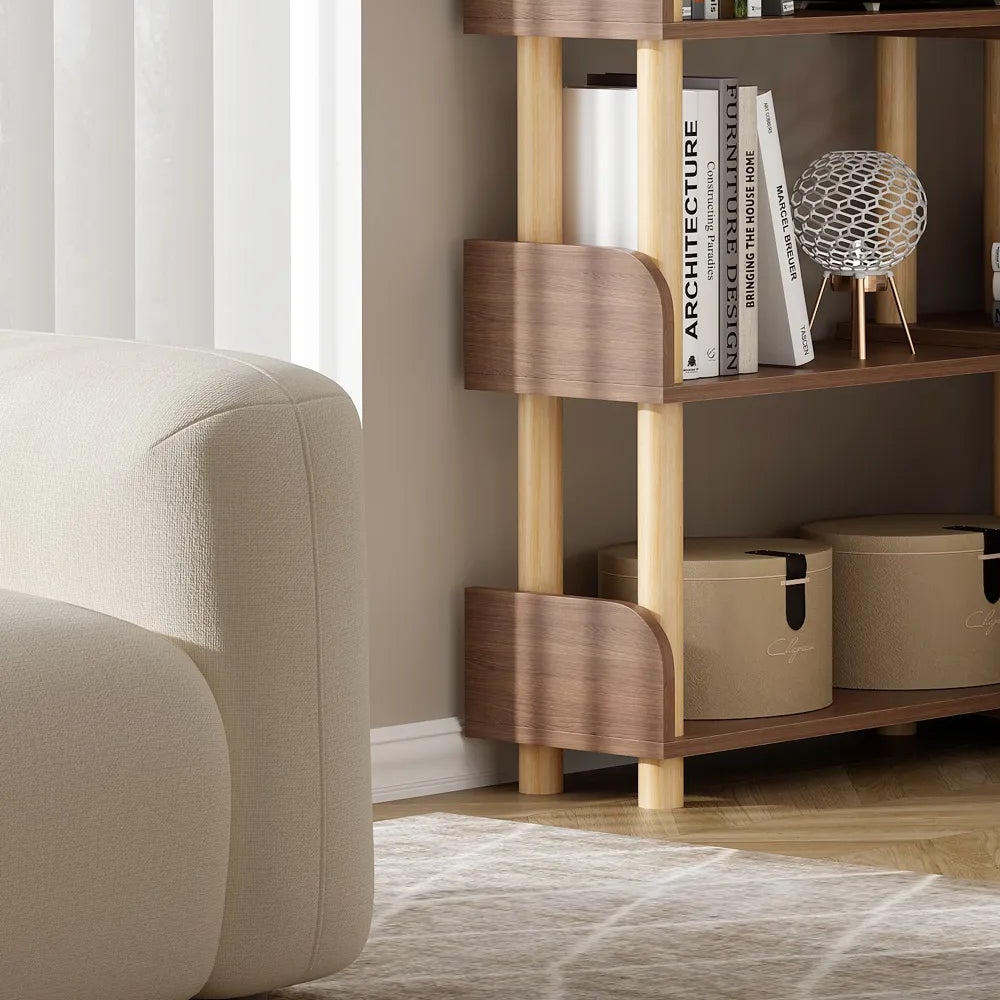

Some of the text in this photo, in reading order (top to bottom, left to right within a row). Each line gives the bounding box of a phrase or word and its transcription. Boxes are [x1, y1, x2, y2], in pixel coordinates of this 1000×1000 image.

[684, 120, 698, 340] ARCHITECTURE
[705, 161, 716, 281] Constructing Paradies
[726, 83, 738, 371] FURNITURE DESIGN
[745, 150, 755, 308] BRINGING THE HOUSE HOME
[776, 184, 797, 281] MARCEL BREUER
